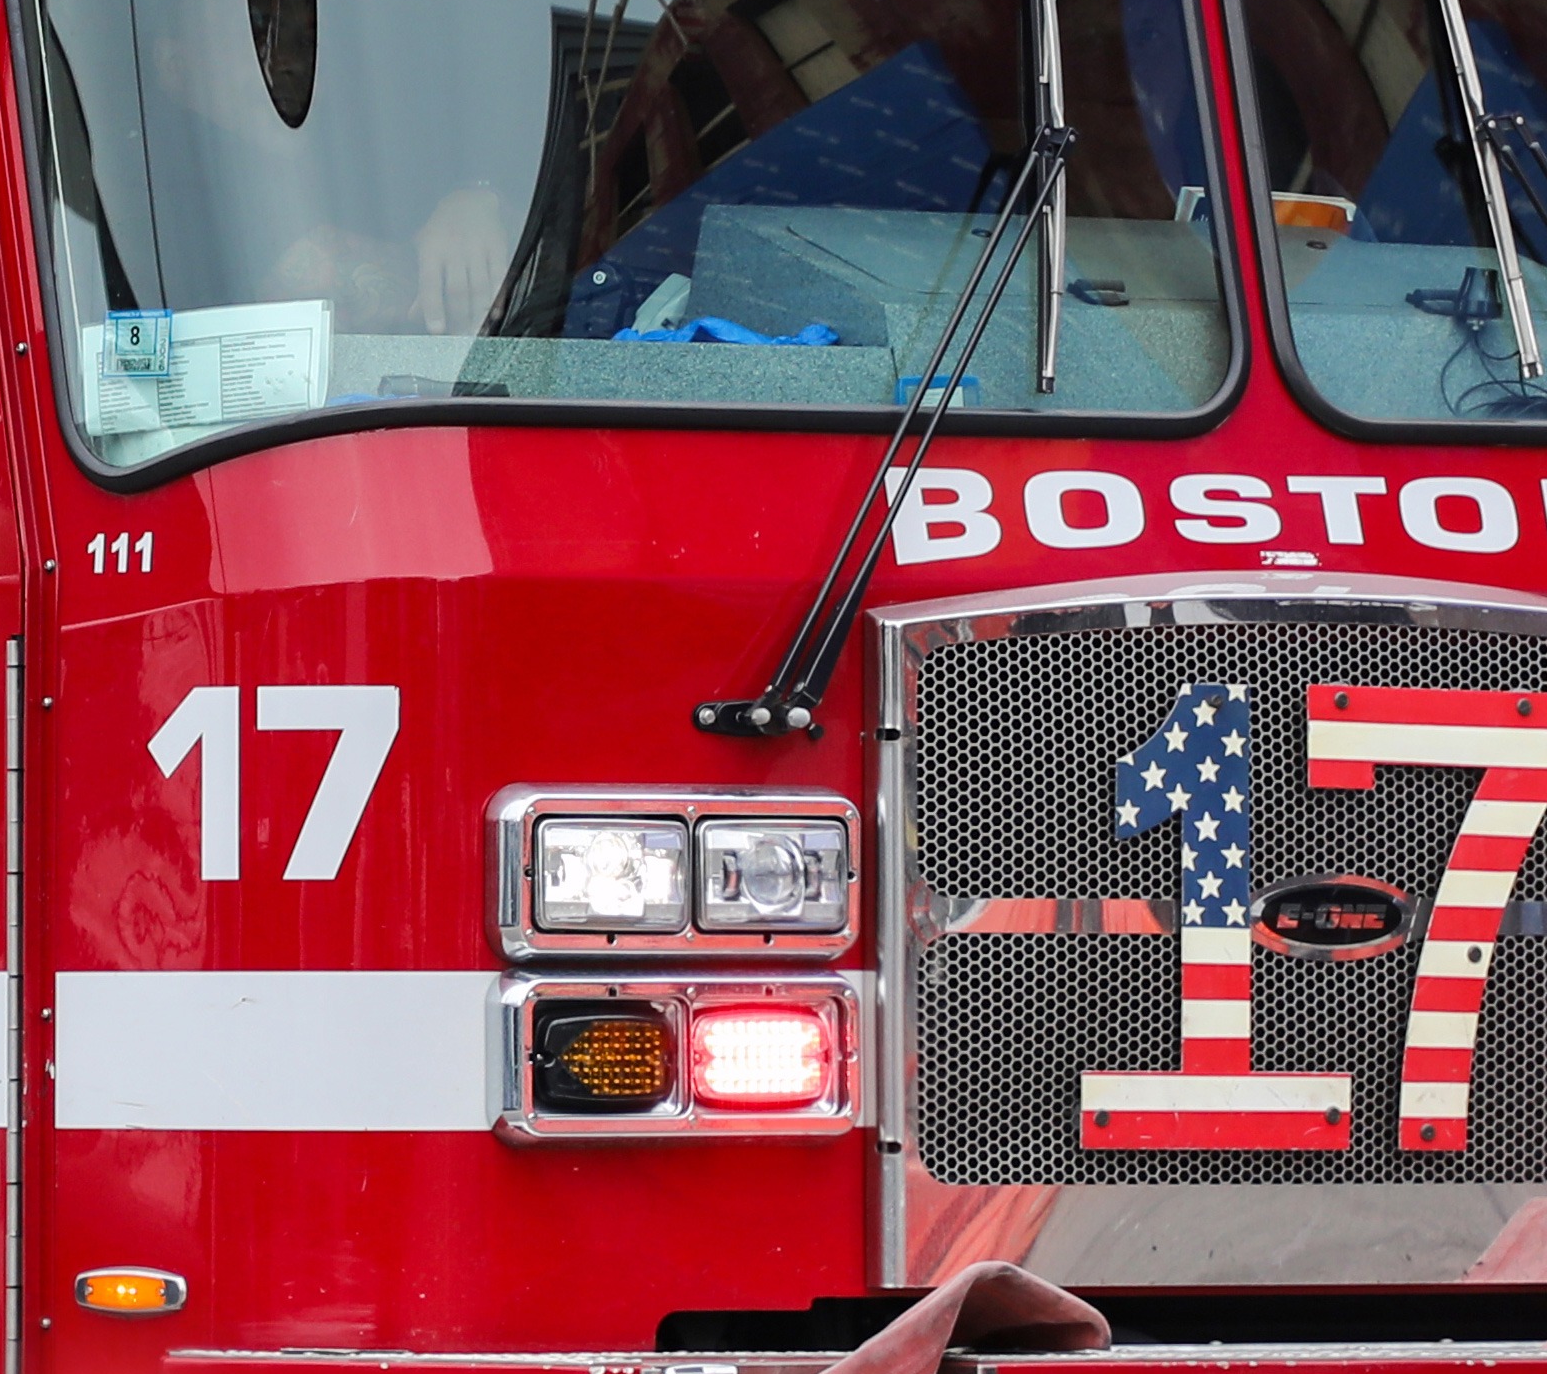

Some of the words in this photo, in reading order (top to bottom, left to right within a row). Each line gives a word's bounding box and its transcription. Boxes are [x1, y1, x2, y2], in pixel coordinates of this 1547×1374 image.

[130, 326, 140, 346] 8
[87, 531, 153, 574] 111
[147, 686, 400, 881] 17
[1276, 903, 1387, 929] E-ONE
